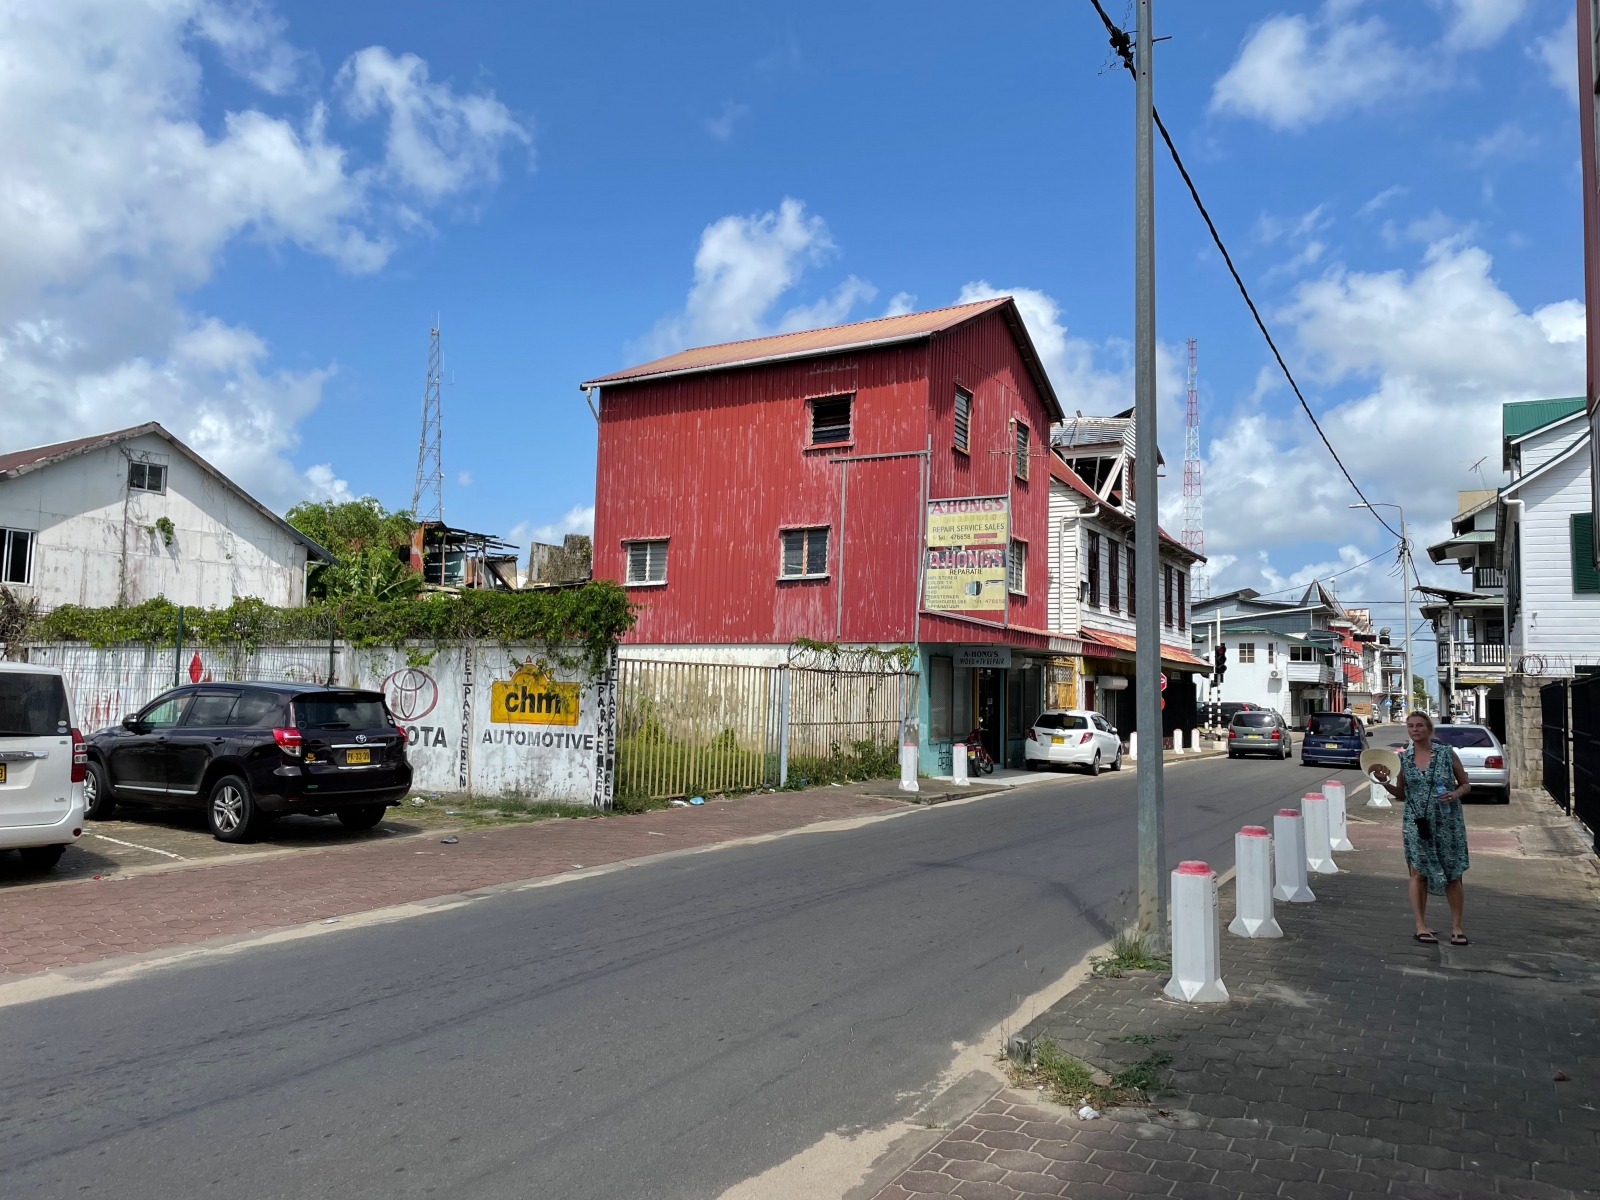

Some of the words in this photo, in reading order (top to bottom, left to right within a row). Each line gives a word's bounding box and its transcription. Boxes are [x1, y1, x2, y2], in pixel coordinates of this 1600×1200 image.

[984, 523, 1005, 531] SALES
[505, 686, 561, 714] chm
[404, 725, 447, 748] OTA
[482, 728, 594, 750] AUTOMOTIVE
